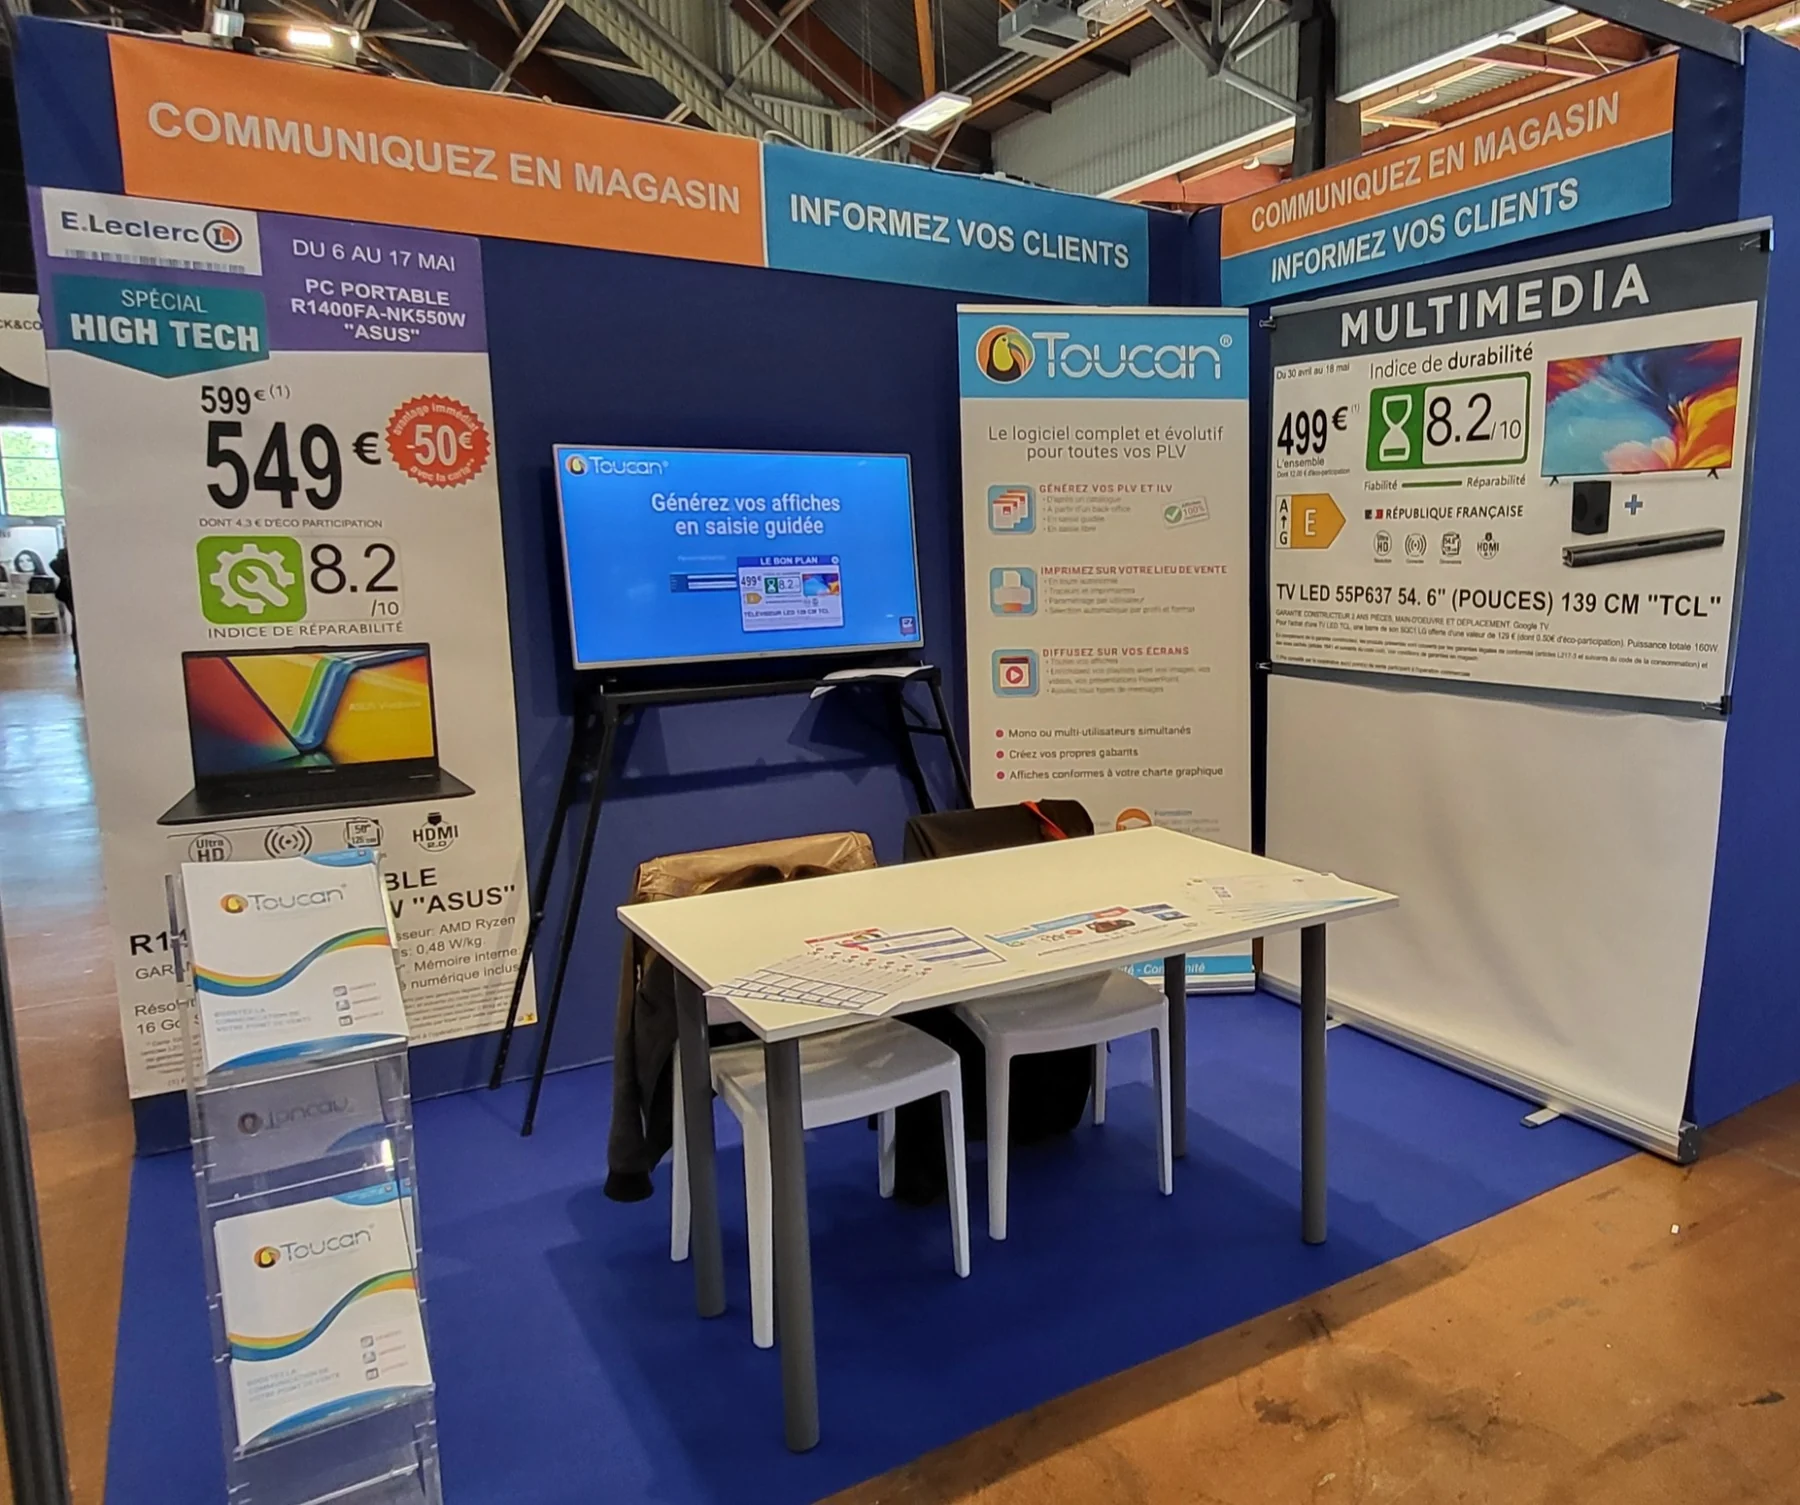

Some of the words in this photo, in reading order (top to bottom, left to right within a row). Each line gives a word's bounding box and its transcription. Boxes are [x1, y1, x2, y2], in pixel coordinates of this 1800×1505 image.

[148, 102, 498, 182] COMMUNIQUEZ
[510, 153, 561, 189] EN
[575, 162, 740, 214] MAGASIN
[1250, 154, 1421, 233] COMMUNIQUEZ
[1428, 141, 1465, 179] EN
[1473, 92, 1619, 167] MAGASIN
[61, 211, 199, 243] E.Leclerc
[790, 194, 951, 243] INFORMEZ
[957, 219, 1015, 252] VOS
[1023, 230, 1129, 268] CLIENTS
[1271, 229, 1386, 284] INFORMEZ
[1392, 213, 1446, 253] VOS
[1454, 177, 1579, 238] CLIENTS
[292, 239, 325, 258] DU
[332, 243, 345, 260] 6
[351, 247, 381, 264] AU
[390, 250, 411, 268] 17
[418, 253, 455, 272] MAI
[121, 288, 208, 313] SPÉCIAL
[305, 278, 334, 297] PC
[341, 282, 450, 307] PORTABLE
[291, 298, 466, 328] R1400FA-NK550W
[1340, 263, 1650, 349] MULTIMEDIA
[70, 313, 158, 346] HIGH
[169, 321, 260, 352] TECH
[344, 323, 420, 343] "ASUS"
[1370, 361, 1416, 380] Indice
[1422, 356, 1442, 373] de
[1448, 341, 1533, 371] durabilité
[1276, 370, 1286, 379] Du
[1288, 368, 1296, 378] 30
[1298, 366, 1312, 377] avril
[1326, 364, 1334, 374] 18
[1336, 363, 1350, 372] mai
[1426, 392, 1491, 447] 8.2
[1490, 419, 1522, 440] /10
[988, 426, 1007, 441] Le
[1012, 425, 1069, 443] logiciel
[1075, 425, 1139, 443] complet
[1145, 427, 1160, 441] et
[1165, 425, 1224, 441] évolutif
[1027, 446, 1063, 461] pour
[1069, 445, 1118, 458] toutes
[1124, 447, 1151, 458] vos
[1157, 444, 1187, 458] PLV
[1276, 456, 1324, 469] L'ensemble
[1039, 482, 1088, 493] GÉNÉREZ
[1092, 484, 1114, 493] VOS
[1117, 484, 1137, 493] PLV
[1140, 484, 1153, 492] ET
[1157, 484, 1172, 492] ILV
[1364, 481, 1398, 491] Fiabilité
[1466, 475, 1526, 488] Réparabilité
[651, 493, 729, 512] Générez
[734, 497, 766, 512] vos
[772, 493, 841, 512] affiches
[1279, 499, 1288, 513] A
[1385, 506, 1453, 520] RÉPUBLIQUE
[1456, 505, 1523, 519] FRANÇAISE
[199, 518, 232, 527] DONT
[254, 519, 262, 527] €
[302, 519, 383, 529] PARTICIPATION
[675, 520, 699, 535] en
[705, 517, 759, 535] saisie
[765, 516, 824, 539] guidée
[1305, 509, 1317, 536] E
[1279, 531, 1288, 545] G
[1377, 541, 1389, 552] HD
[1477, 542, 1499, 552] HDMI
[310, 543, 398, 594] 8.2
[760, 558, 772, 566] LE
[774, 557, 793, 565] BON
[795, 556, 818, 565] PLAN
[1040, 566, 1093, 575] IMPRIMEZ
[1096, 566, 1116, 574] SUR
[1118, 566, 1153, 574] VOTRE
[1154, 566, 1177, 574] LIEU
[1179, 566, 1192, 574] DE
[1194, 565, 1227, 574] VENTE
[371, 600, 399, 617] /10
[1276, 584, 1296, 600] TV
[1300, 584, 1330, 602] LED
[1335, 586, 1392, 605] 55P637
[1451, 588, 1553, 616] (POUCES)
[1561, 592, 1597, 612] 139
[1604, 593, 1639, 614] CM
[1648, 594, 1721, 617] "TCL"
[1275, 609, 1301, 617] GARANTIE
[1304, 610, 1350, 619] CONSTRUCTEUR
[1513, 621, 1537, 631] Google
[208, 626, 267, 639] INDICE
[273, 625, 294, 637] DE
[300, 620, 403, 636] RÉPARABILITÉ
[1042, 648, 1093, 657] DIFFUSEZ
[1097, 648, 1118, 656] SUR
[1121, 647, 1143, 655] VOS
[1146, 646, 1189, 655] ÉCRANS
[1627, 639, 1667, 650] Puissance
[1669, 642, 1691, 651] totale
[1008, 729, 1037, 738] Mono
[1040, 730, 1051, 738] ou
[1054, 727, 1135, 737] multi-utilisateurs
[1138, 726, 1191, 736] simultanés
[1009, 749, 1037, 759] Créez
[1059, 750, 1096, 760] propres
[1010, 770, 1049, 780] Affiches
[1052, 768, 1104, 779] conformes
[1107, 768, 1113, 777] à
[1115, 769, 1139, 778] votre
[1142, 767, 1173, 777] charte
[1175, 766, 1223, 778] graphique
[413, 825, 458, 842] HDMI
[196, 838, 224, 849] Ultra
[200, 848, 224, 862] HD
[384, 867, 437, 891] BLE
[413, 884, 515, 914] "ASUS"
[440, 921, 471, 935] AMD
[475, 916, 515, 931] Ryzen
[414, 954, 470, 972] Mémoire
[411, 969, 480, 989] numérique
[137, 1022, 155, 1035] 16
